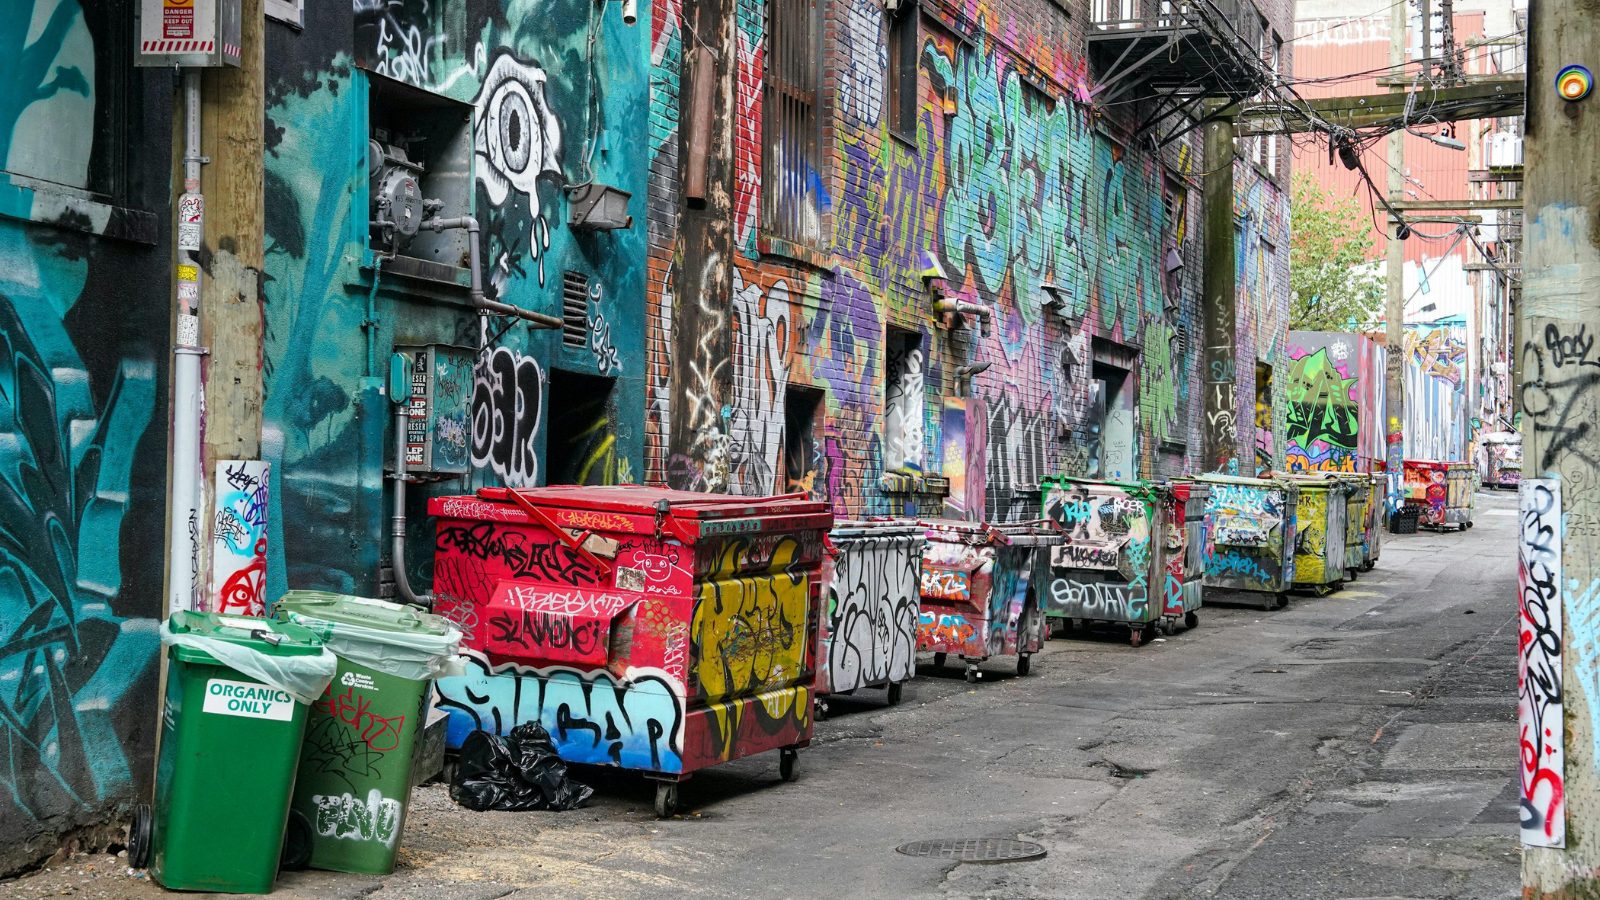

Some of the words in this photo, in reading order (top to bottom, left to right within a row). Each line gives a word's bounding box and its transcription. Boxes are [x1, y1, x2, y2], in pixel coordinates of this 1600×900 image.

[412, 375, 427, 383] ESER
[410, 401, 426, 409] LEP
[408, 422, 426, 431] RESER
[406, 447, 423, 455] LEP
[209, 683, 293, 704] ORGANICS
[227, 699, 272, 715] ONLY
